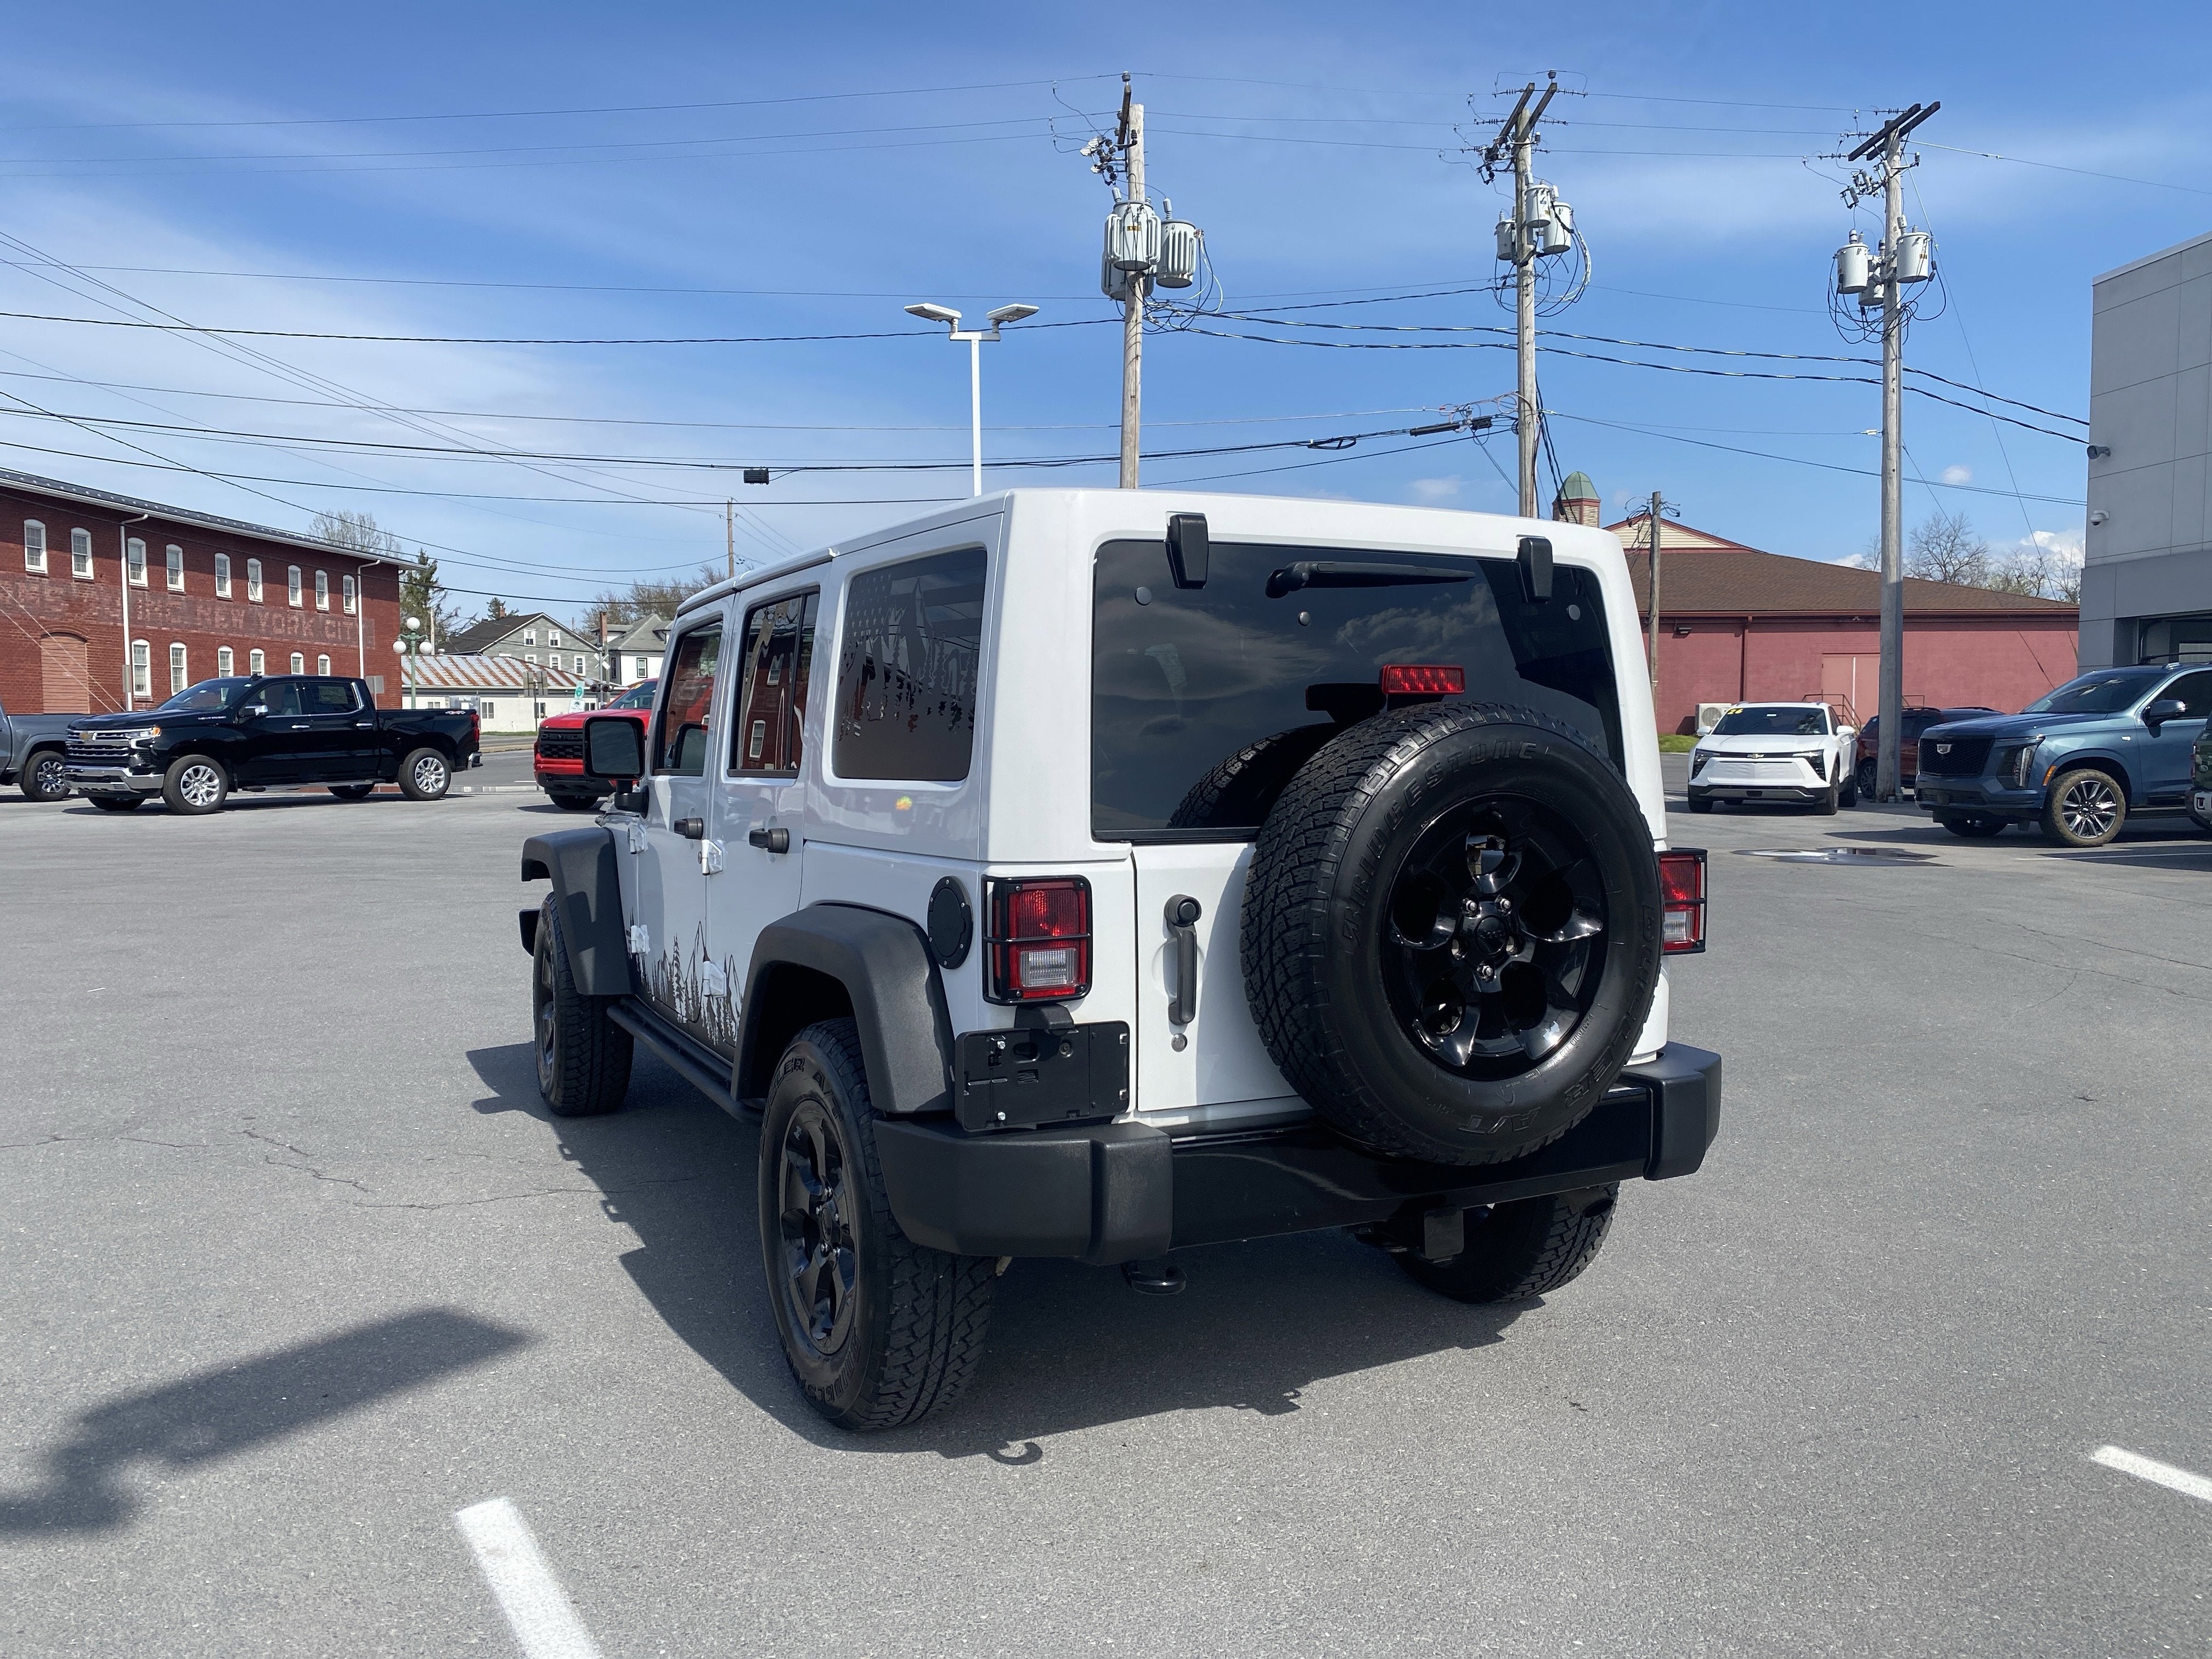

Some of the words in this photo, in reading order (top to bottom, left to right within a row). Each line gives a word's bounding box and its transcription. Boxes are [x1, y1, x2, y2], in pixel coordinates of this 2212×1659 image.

[196, 605, 245, 629] NEW
[258, 611, 314, 637] YORK
[1342, 740, 1537, 945] BRIDGESTONE
[1565, 904, 1655, 1108] DUELER
[1458, 1106, 1542, 1135] A/T
